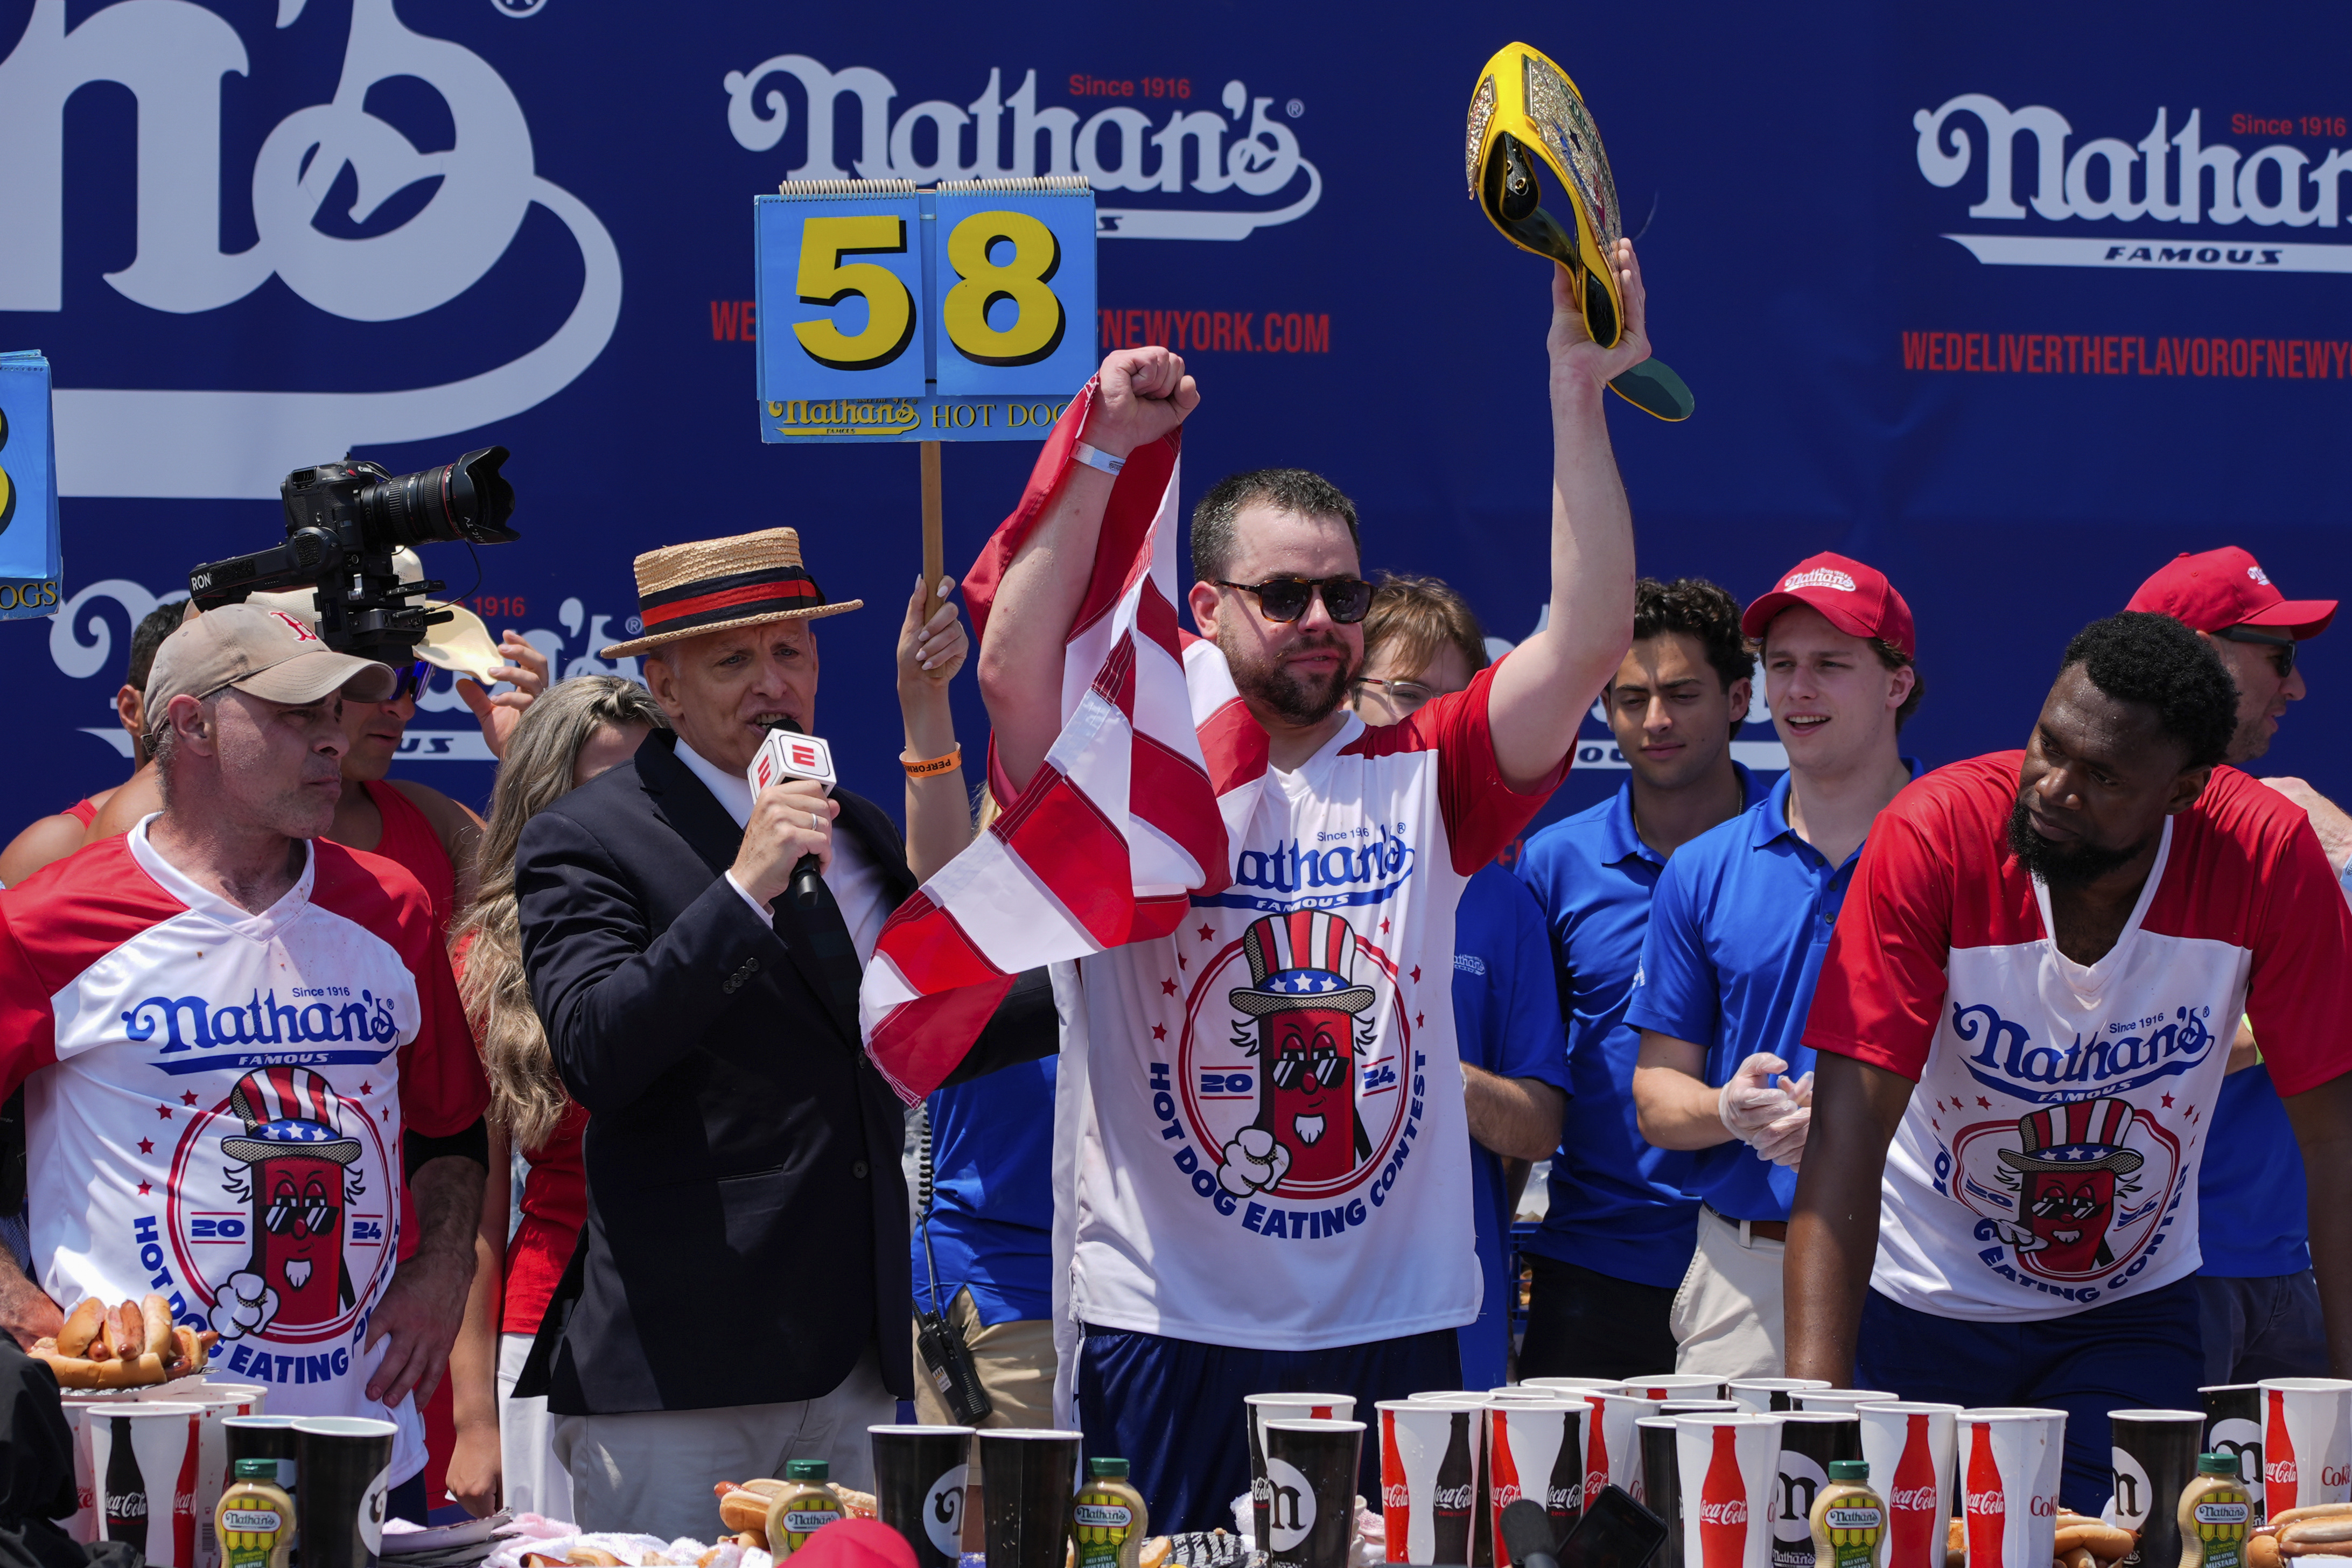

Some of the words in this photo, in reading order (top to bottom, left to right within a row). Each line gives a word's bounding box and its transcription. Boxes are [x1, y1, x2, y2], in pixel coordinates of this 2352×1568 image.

[1069, 74, 1134, 99] Since
[1139, 76, 1191, 100] 1916
[723, 54, 1322, 195] Nathan's
[2232, 114, 2293, 136] Since
[2299, 116, 2347, 137] 1916
[2104, 246, 2283, 265] FAMOUS
[1902, 331, 2352, 380] WEDELIVERTHEFLAVOROFNEWY
[932, 404, 997, 429] HOT
[1784, 569, 1856, 588] Nathan's
[473, 597, 526, 617] 1916
[1317, 830, 1347, 842] Since
[1256, 894, 1350, 912] FAMOUS
[292, 986, 324, 998] Since
[326, 986, 350, 997] 1916
[121, 988, 399, 1054] Nathan's
[2109, 1021, 2136, 1034] Since
[2139, 1013, 2164, 1028] 1916
[1952, 1002, 2215, 1084] Nathan's
[238, 1053, 330, 1066] FAMOUS
[1201, 1074, 1253, 1093] 20
[1363, 1065, 1396, 1089] 24
[2037, 1080, 2132, 1102] FAMOUS
[1150, 1062, 1186, 1140] HOT
[1173, 1145, 1238, 1216] DOG
[1242, 1198, 1367, 1239] EATING
[1370, 1050, 1426, 1207] CONTEST
[192, 1220, 245, 1237] 20
[352, 1221, 382, 1240] 24
[1978, 1245, 2101, 1304] EATING
[134, 1215, 174, 1290] HOT
[228, 1347, 348, 1384] EATING
[1891, 1486, 1936, 1511] Coca-Cola
[226, 1512, 276, 1525] Nathan's
[1077, 1507, 1128, 1520] Nathan's
[1699, 1500, 1748, 1525] Coca-Cola
[1830, 1509, 1878, 1522] Nathan's
[2199, 1506, 2246, 1518] Nathan's
[2206, 1557, 2238, 1568] MUSTARD
